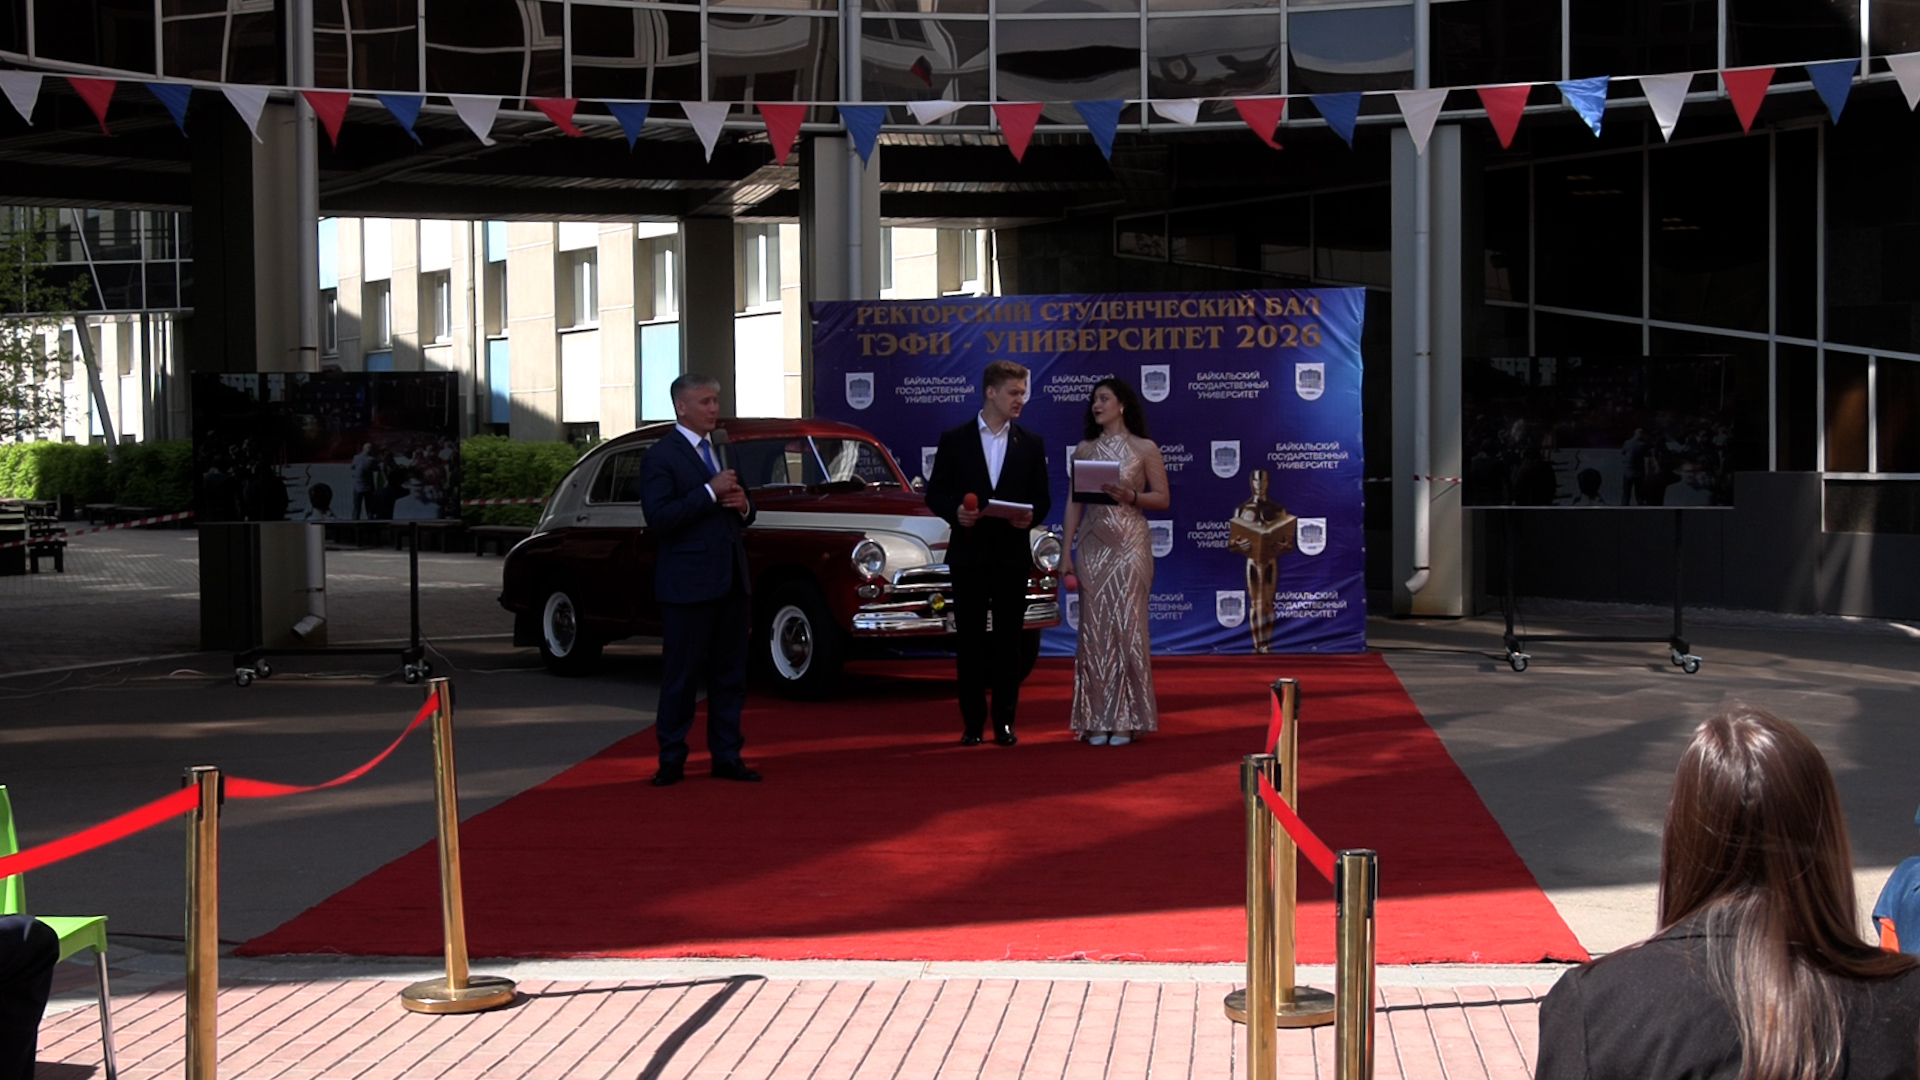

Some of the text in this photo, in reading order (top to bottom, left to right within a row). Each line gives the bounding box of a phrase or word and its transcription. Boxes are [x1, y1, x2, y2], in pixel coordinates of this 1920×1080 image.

[857, 295, 1321, 326] РЕКТОРСКИЙ СТУДЕНЧЕСКИЙ БАЛ
[857, 332, 951, 357] ТЭФИ
[984, 325, 1225, 354] УНИВЕРСИТЕТ
[1236, 323, 1322, 349] 2026
[904, 375, 967, 386] БАЙКАЛЬСКИЙ
[1197, 370, 1260, 381] БАЙКАЛЬСКИЙ
[895, 384, 975, 395] ГОСУДАРСТВЕННЫЙ
[1043, 384, 1095, 393] ГОСУДАРСТВ
[1188, 380, 1269, 391] ГОСУДАРСТВЕННЫЙ
[904, 394, 966, 404] УНИВЕРСИТЕТ
[1052, 393, 1091, 403] УНИВЕРС
[1197, 389, 1260, 400] УНИВЕРСИТЕТ
[1276, 441, 1340, 451] БАЙКАЛЬСКИЙ
[1267, 450, 1349, 461] ГОСУДАРСТВЕННЫЙ
[1277, 460, 1340, 470] УНИВЕРСИТЕТ
[1196, 520, 1231, 531] БАЙКАЛ
[1187, 531, 1230, 540] ГОСУДАРС
[1275, 590, 1339, 601] БАЙКАЛЬСКИЙ
[1275, 609, 1338, 619] УНИВЕРСИТЕТ
